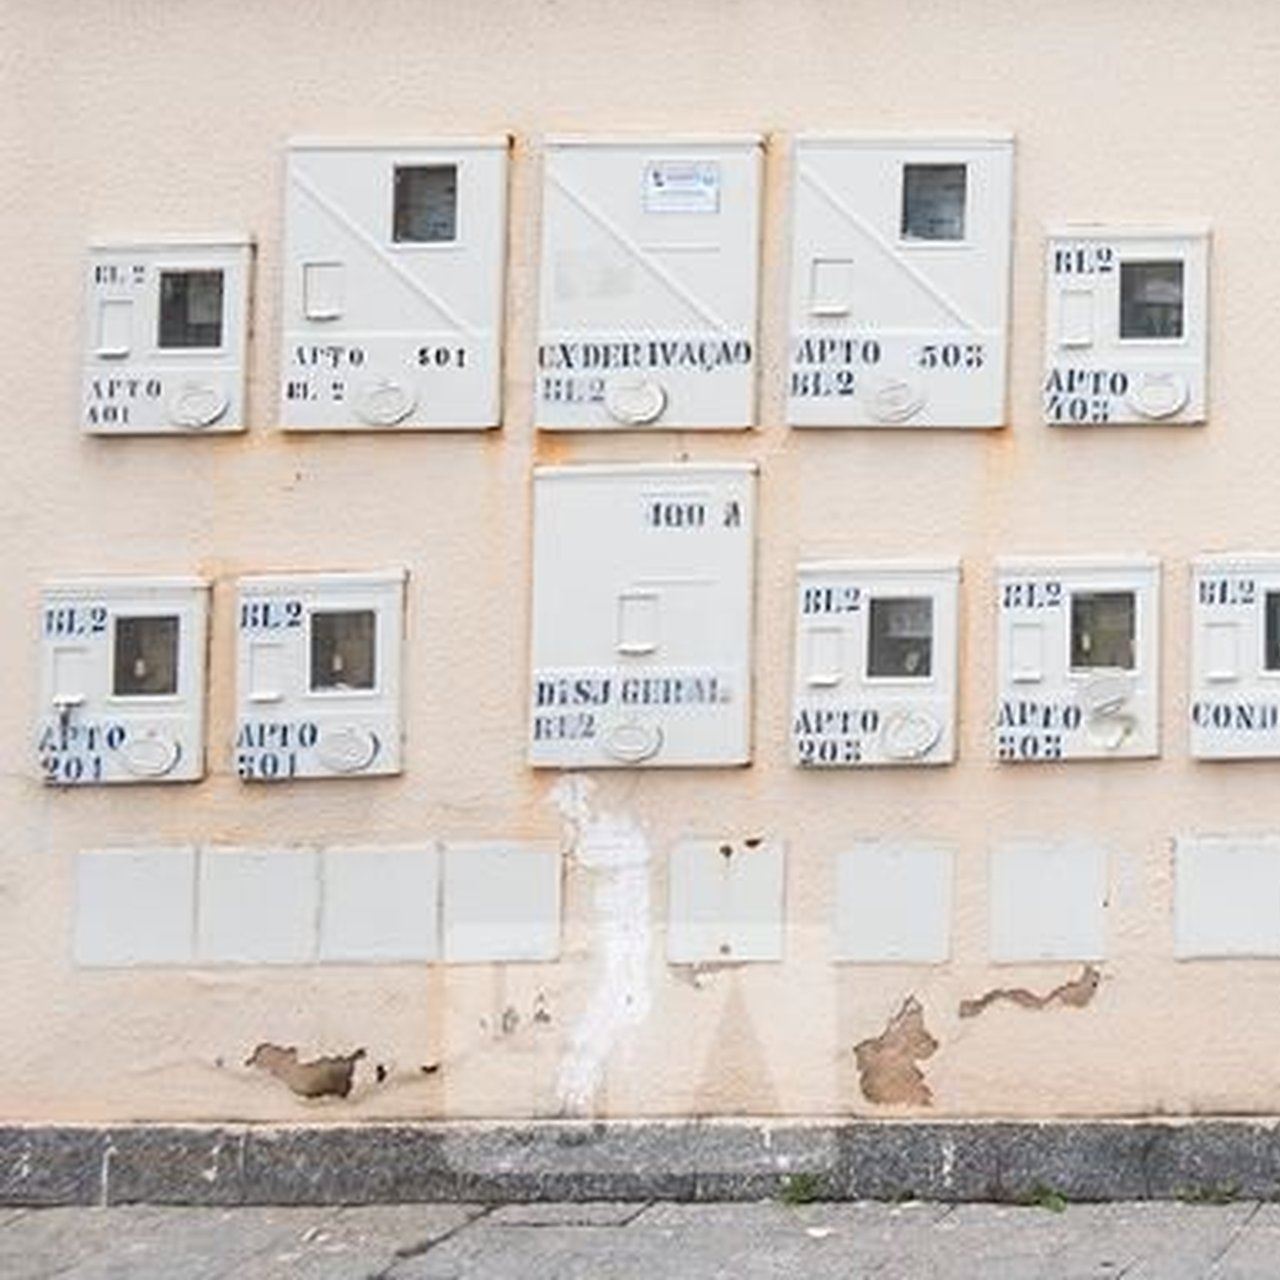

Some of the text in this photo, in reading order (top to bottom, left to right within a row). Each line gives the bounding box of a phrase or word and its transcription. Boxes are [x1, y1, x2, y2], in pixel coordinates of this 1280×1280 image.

[293, 346, 466, 368] APTO 501
[795, 338, 984, 368] APTO 503
[92, 379, 162, 399] APTO
[1045, 368, 1129, 396] APTO
[651, 500, 742, 528] 100 A
[620, 677, 732, 705] GERAL
[795, 709, 879, 734] APTO
[998, 701, 1082, 731] APTO
[1193, 702, 1278, 730] COND
[39, 725, 126, 752] APTO
[237, 721, 318, 749] APTO
